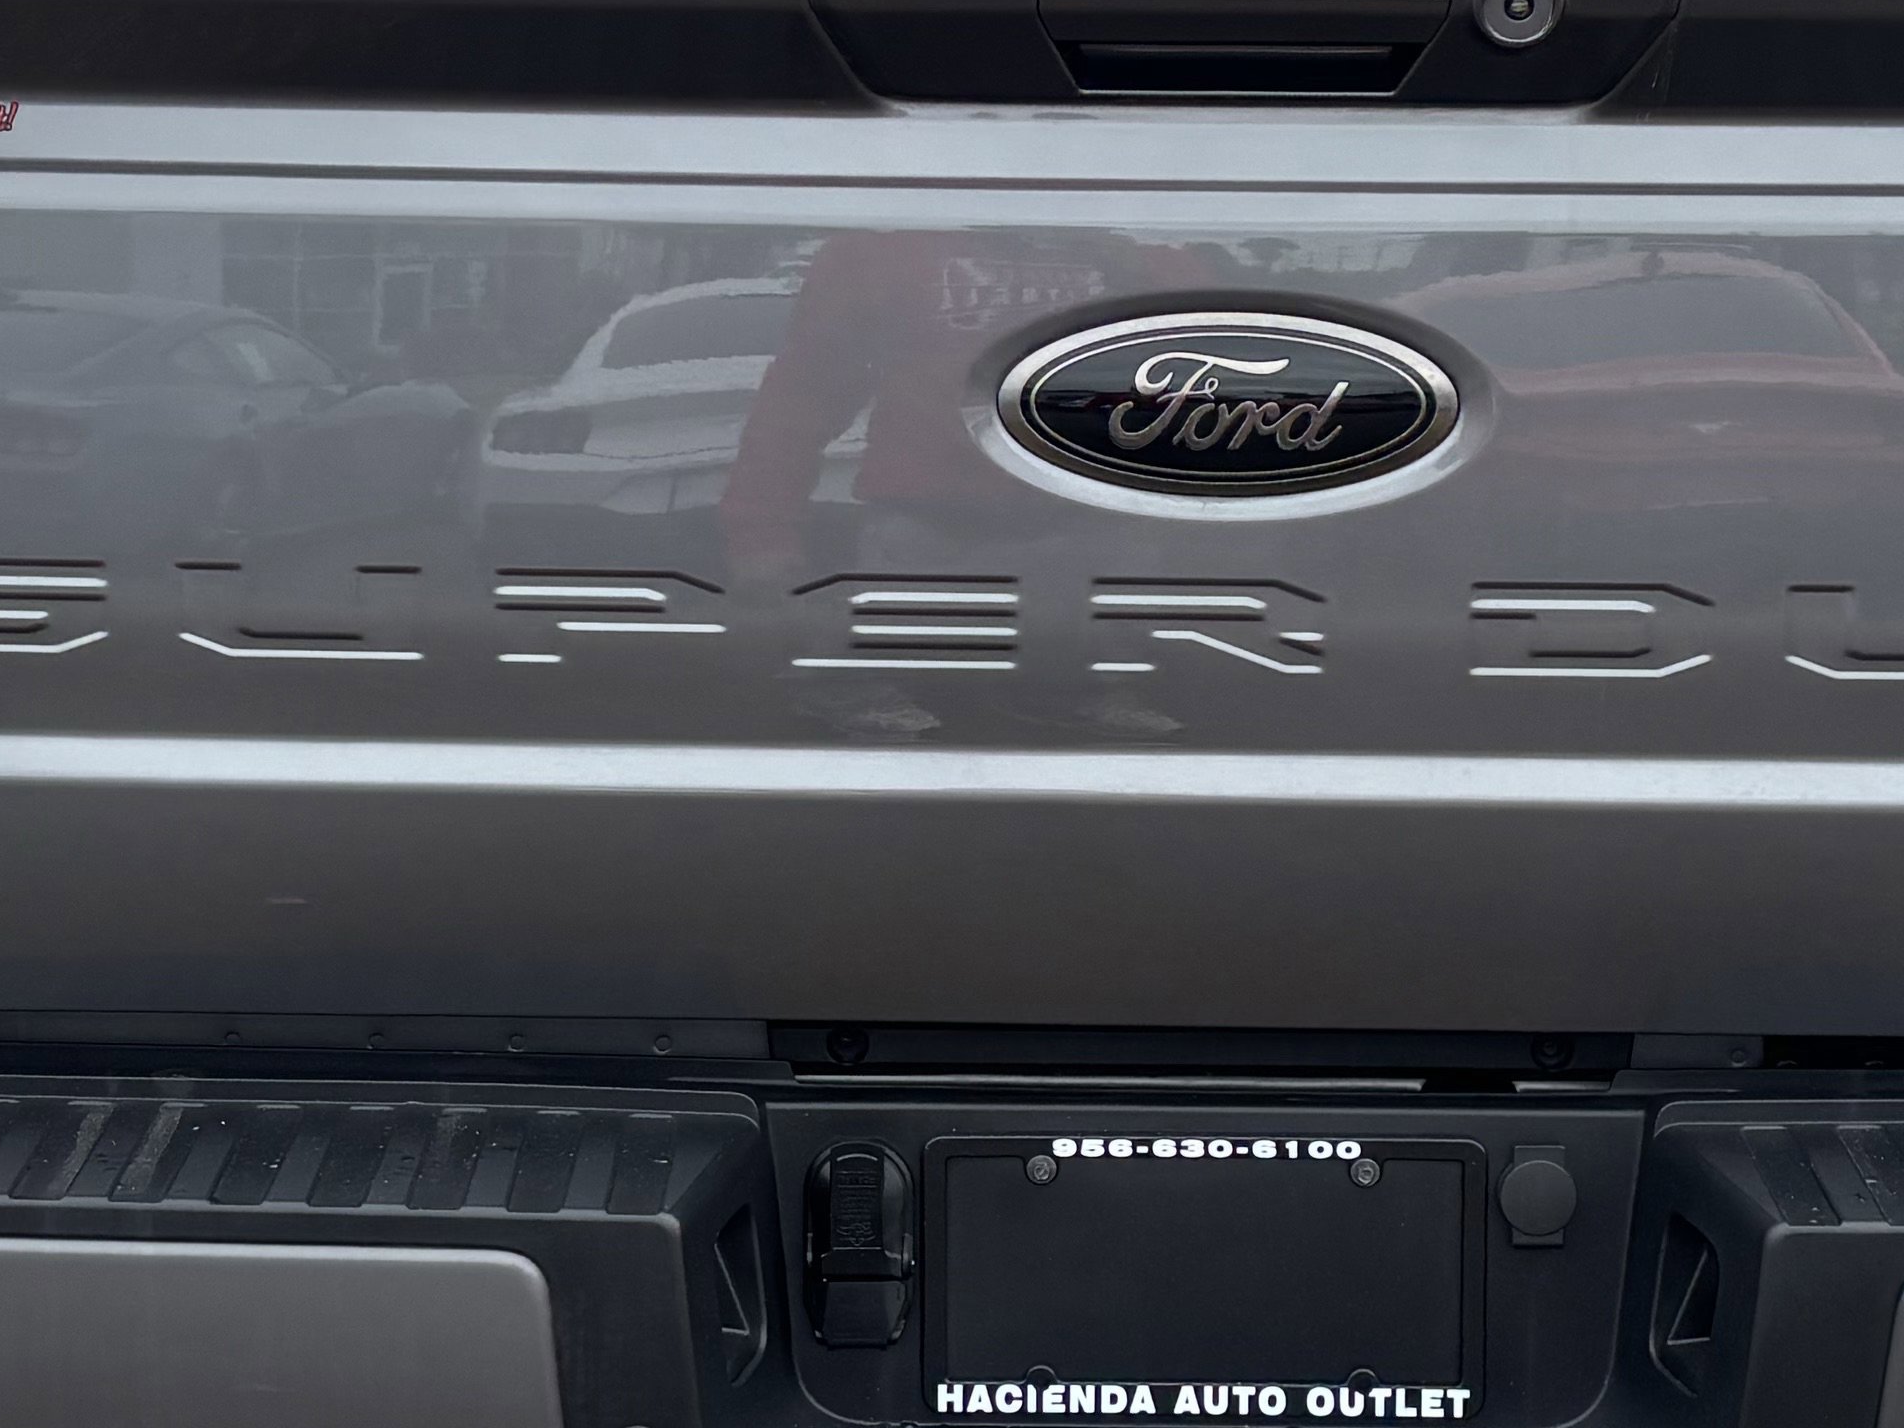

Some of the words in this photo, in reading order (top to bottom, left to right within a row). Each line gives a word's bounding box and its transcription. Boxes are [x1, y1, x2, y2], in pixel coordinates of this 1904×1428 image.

[1108, 351, 1351, 452] Ford
[1051, 1137, 1363, 1161] 956-630-6100
[936, 1382, 1157, 1415] HACIENDA
[1172, 1384, 1288, 1417] AUTO
[1305, 1385, 1472, 1420] OUTLET
